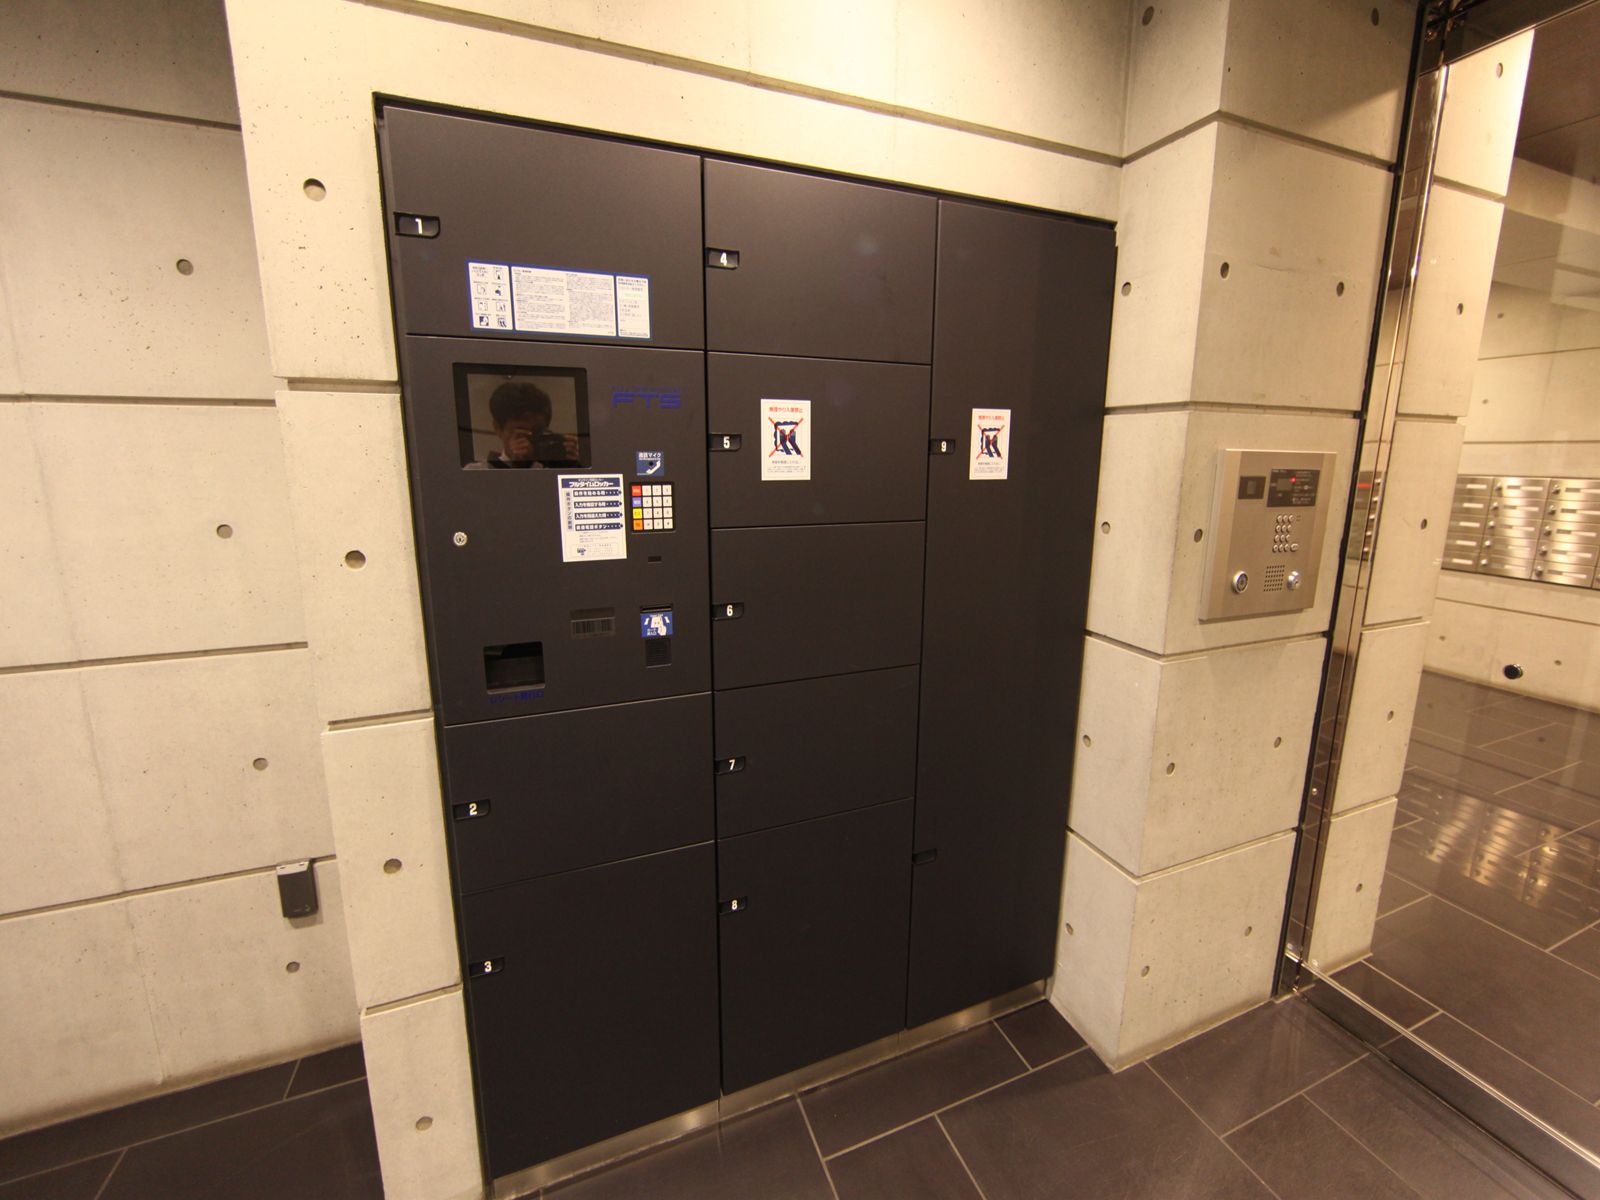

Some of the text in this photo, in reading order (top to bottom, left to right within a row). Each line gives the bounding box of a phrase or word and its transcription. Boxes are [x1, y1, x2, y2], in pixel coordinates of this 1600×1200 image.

[415, 218, 423, 235] 1
[720, 252, 728, 267] 4
[612, 391, 681, 409] FTS
[724, 436, 731, 449] 5
[941, 441, 947, 453] 9
[726, 604, 733, 617] 6
[729, 759, 736, 771] 7
[470, 803, 478, 816] 2
[731, 899, 738, 911] 8
[485, 960, 492, 973] 3
